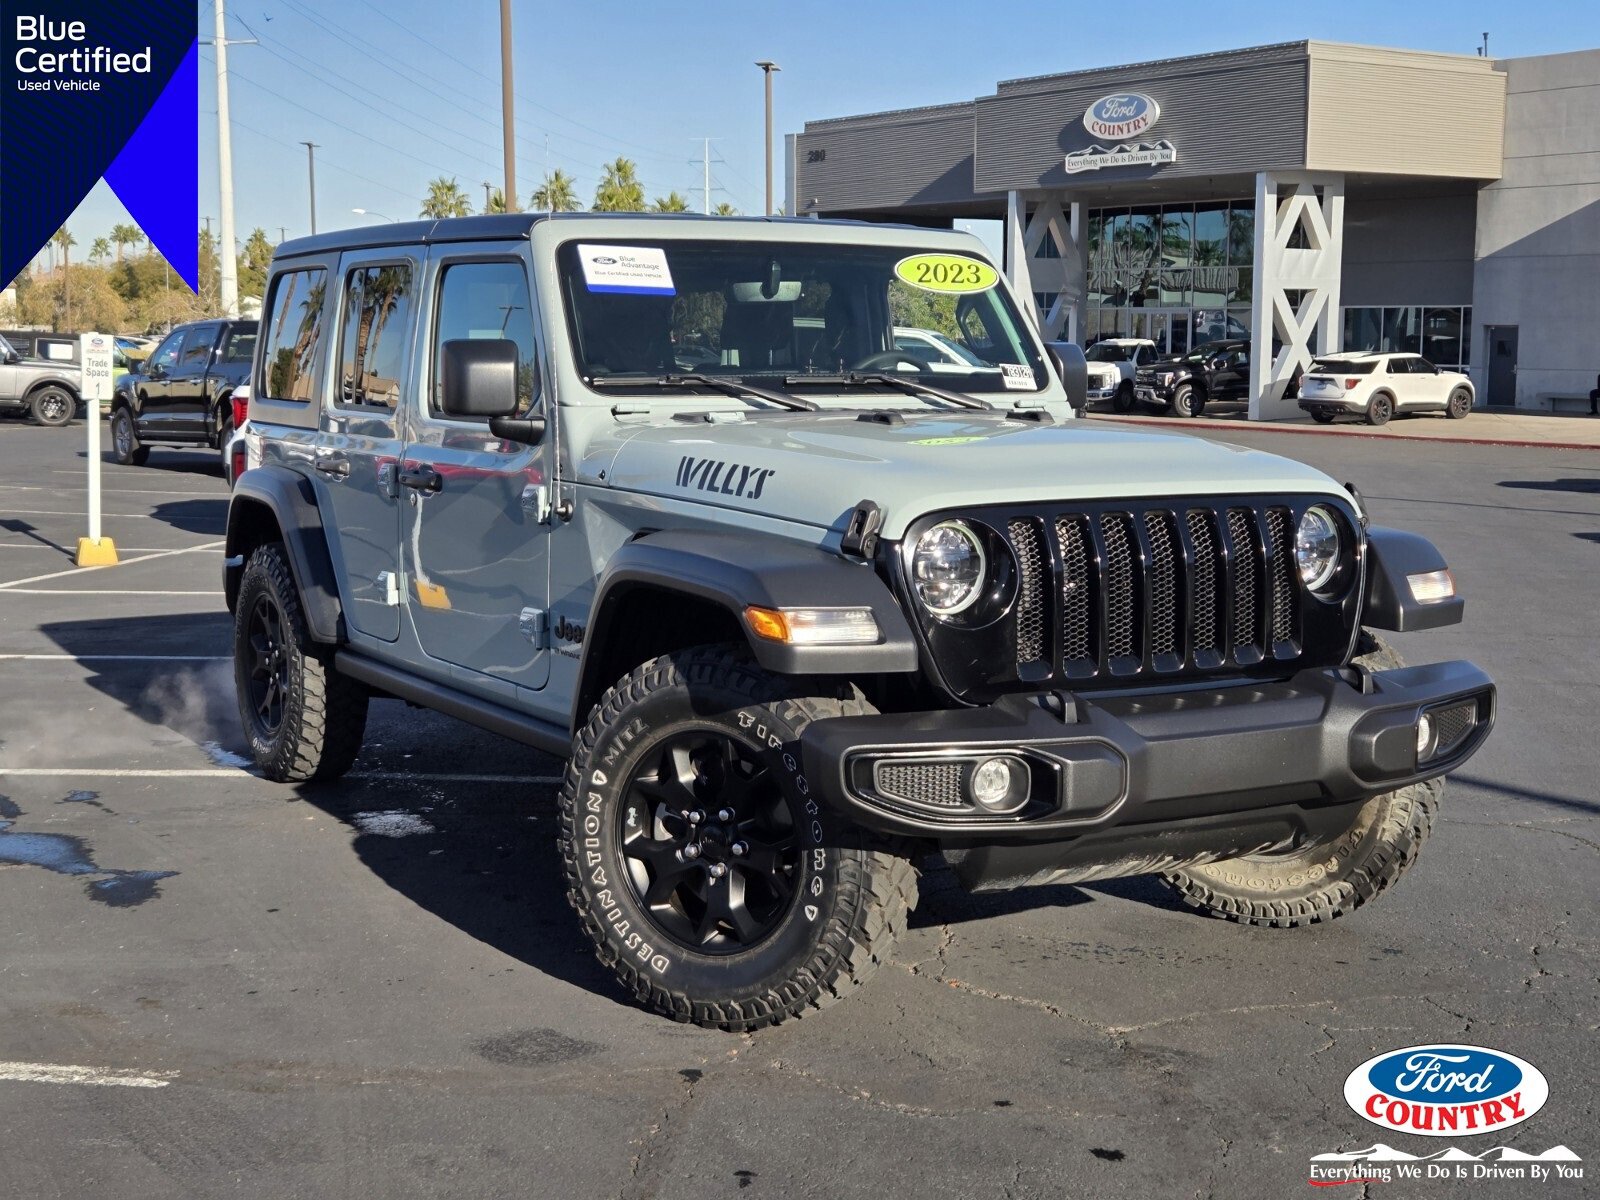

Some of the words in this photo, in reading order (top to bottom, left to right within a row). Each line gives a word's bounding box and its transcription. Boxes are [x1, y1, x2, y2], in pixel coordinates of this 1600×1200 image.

[1102, 97, 1138, 119] Ford
[1091, 114, 1149, 136] COUNTRY
[1067, 157, 1098, 168] Everything
[1128, 154, 1148, 162] Driven
[1149, 153, 1158, 162] By
[1159, 152, 1172, 160] You
[916, 262, 981, 284] 2023
[86, 368, 109, 378] Space
[87, 358, 108, 367] Trade
[95, 382, 101, 395] 1
[676, 456, 776, 499] WILLYS
[603, 717, 650, 767] M/T2
[737, 711, 826, 897] Firestone
[584, 791, 670, 974] DESTINATION
